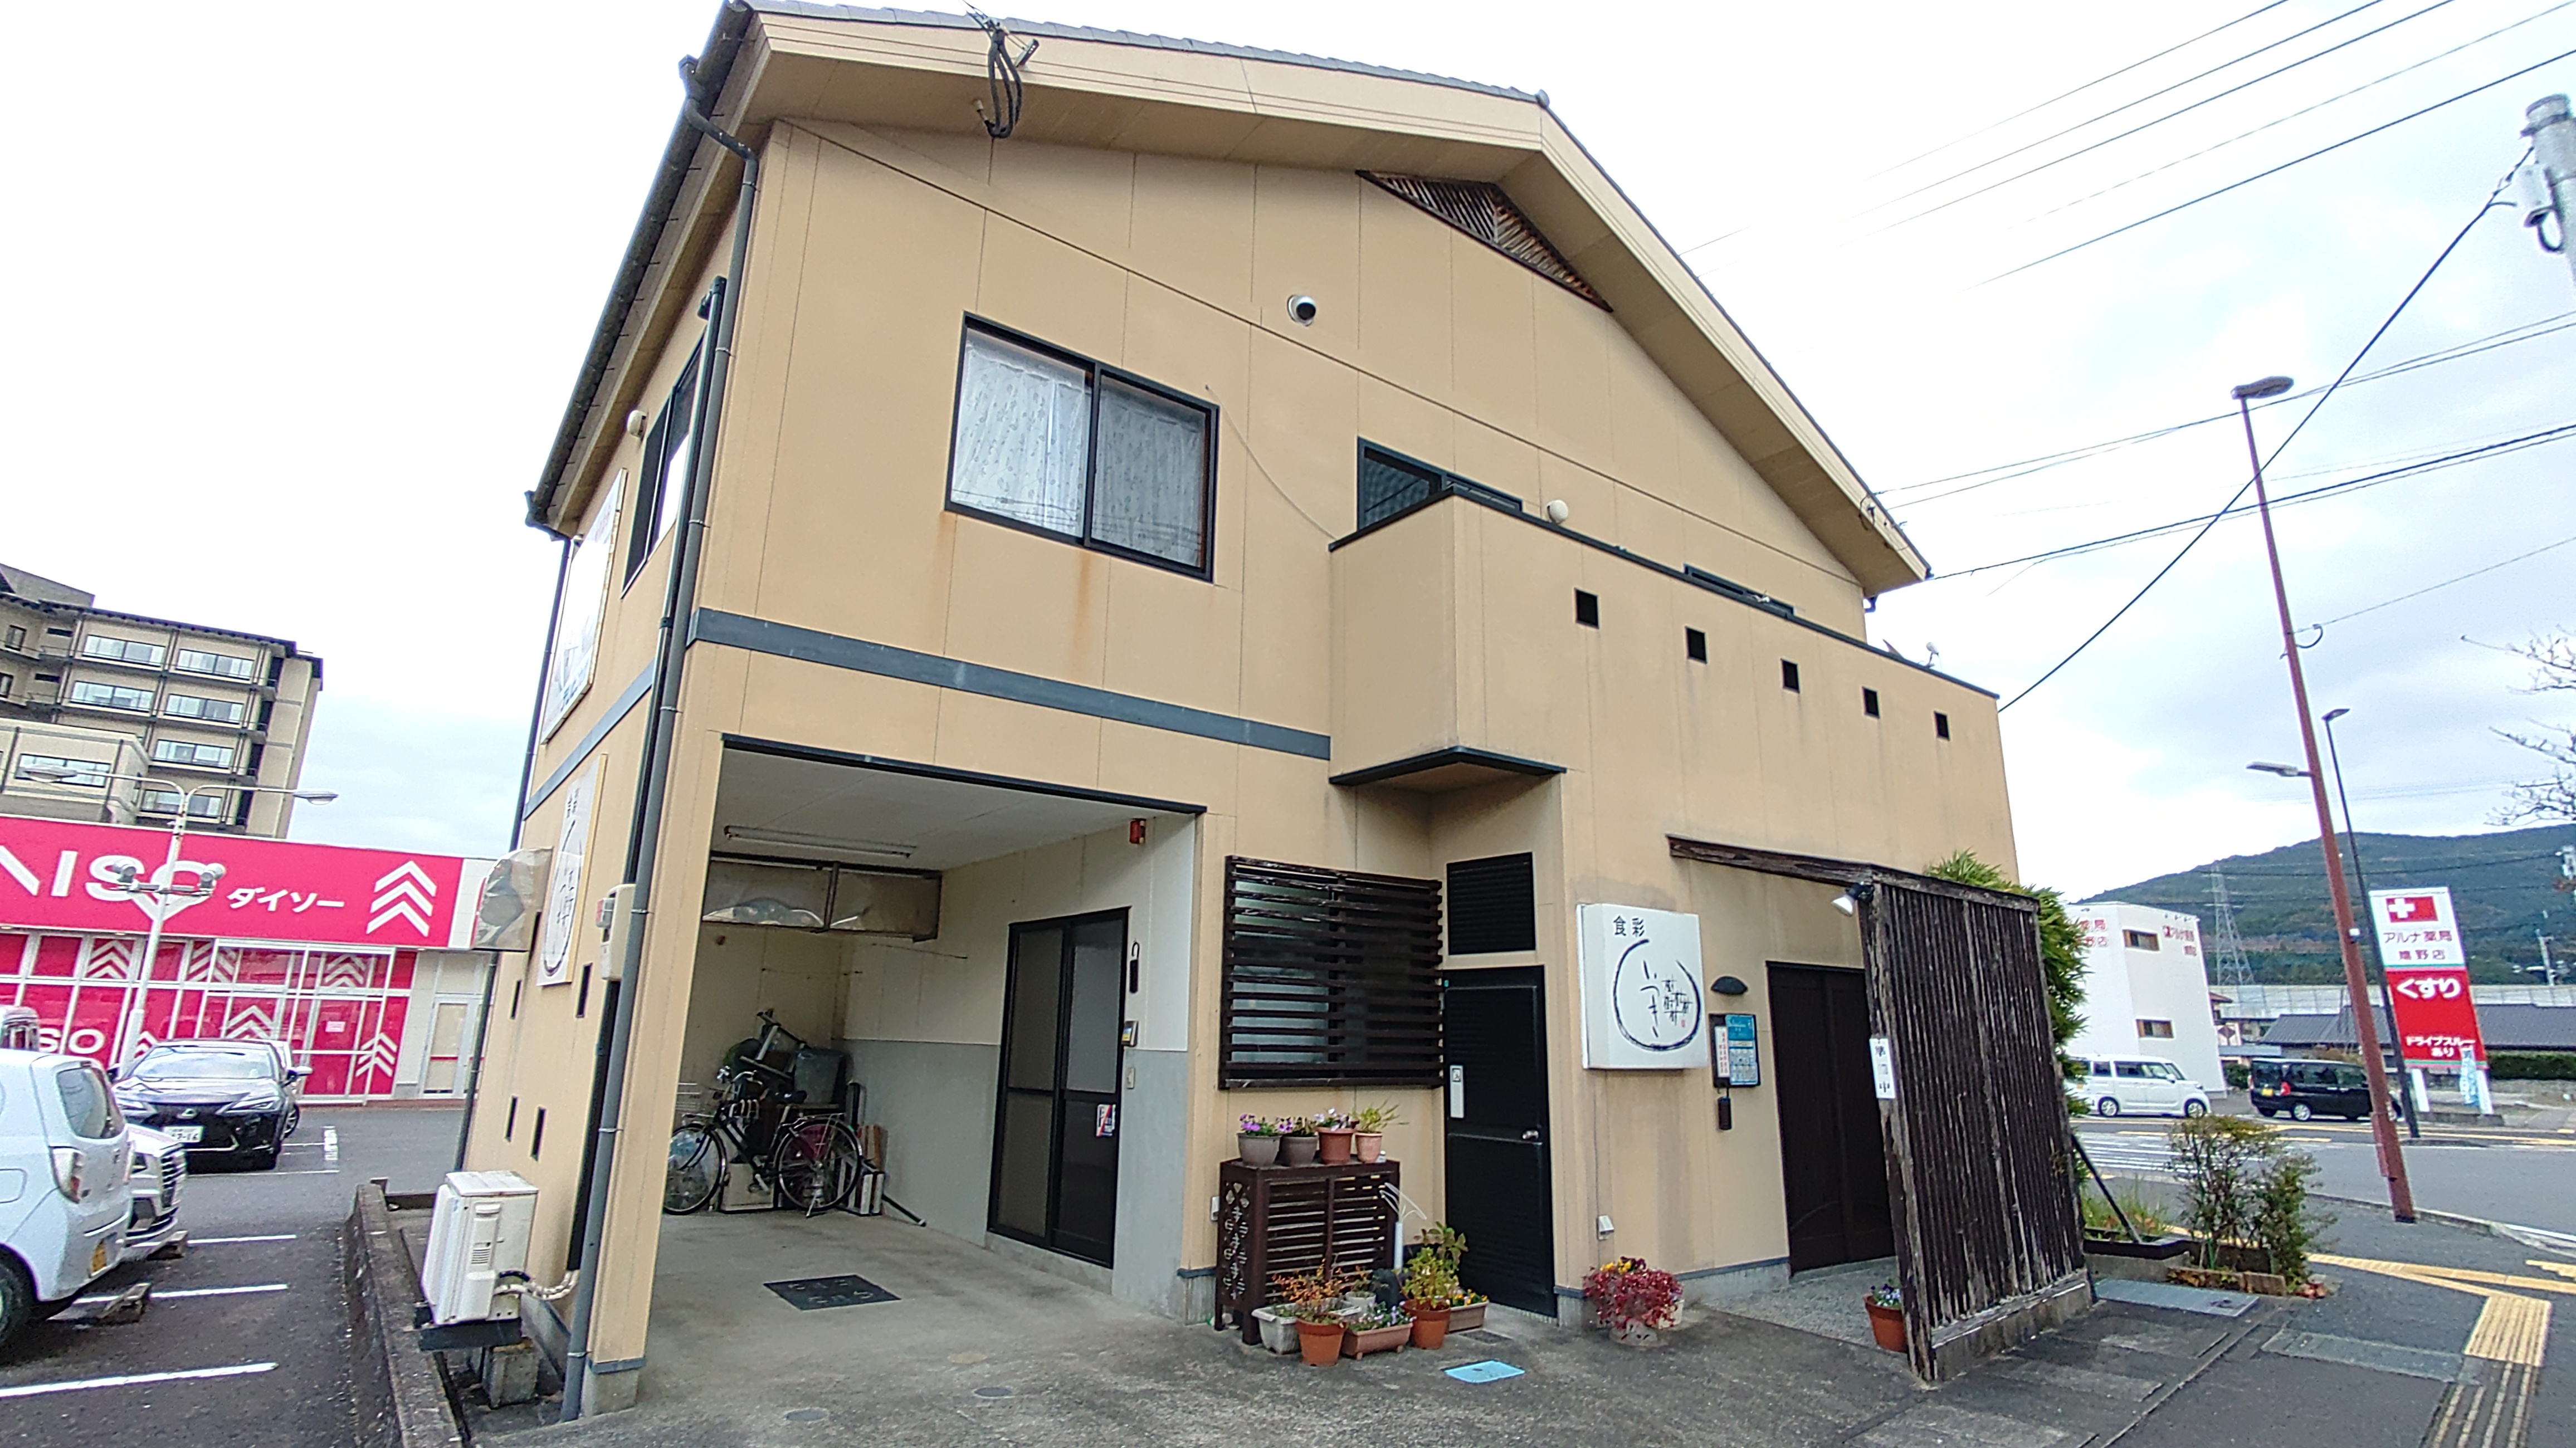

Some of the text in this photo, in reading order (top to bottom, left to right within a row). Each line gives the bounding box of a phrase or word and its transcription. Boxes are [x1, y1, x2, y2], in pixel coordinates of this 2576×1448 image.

[227, 887, 344, 912] ダイソー
[1613, 915, 1645, 937] 食彩
[2383, 930, 2452, 943] アルナ薬局
[2397, 978, 2461, 999] くすり
